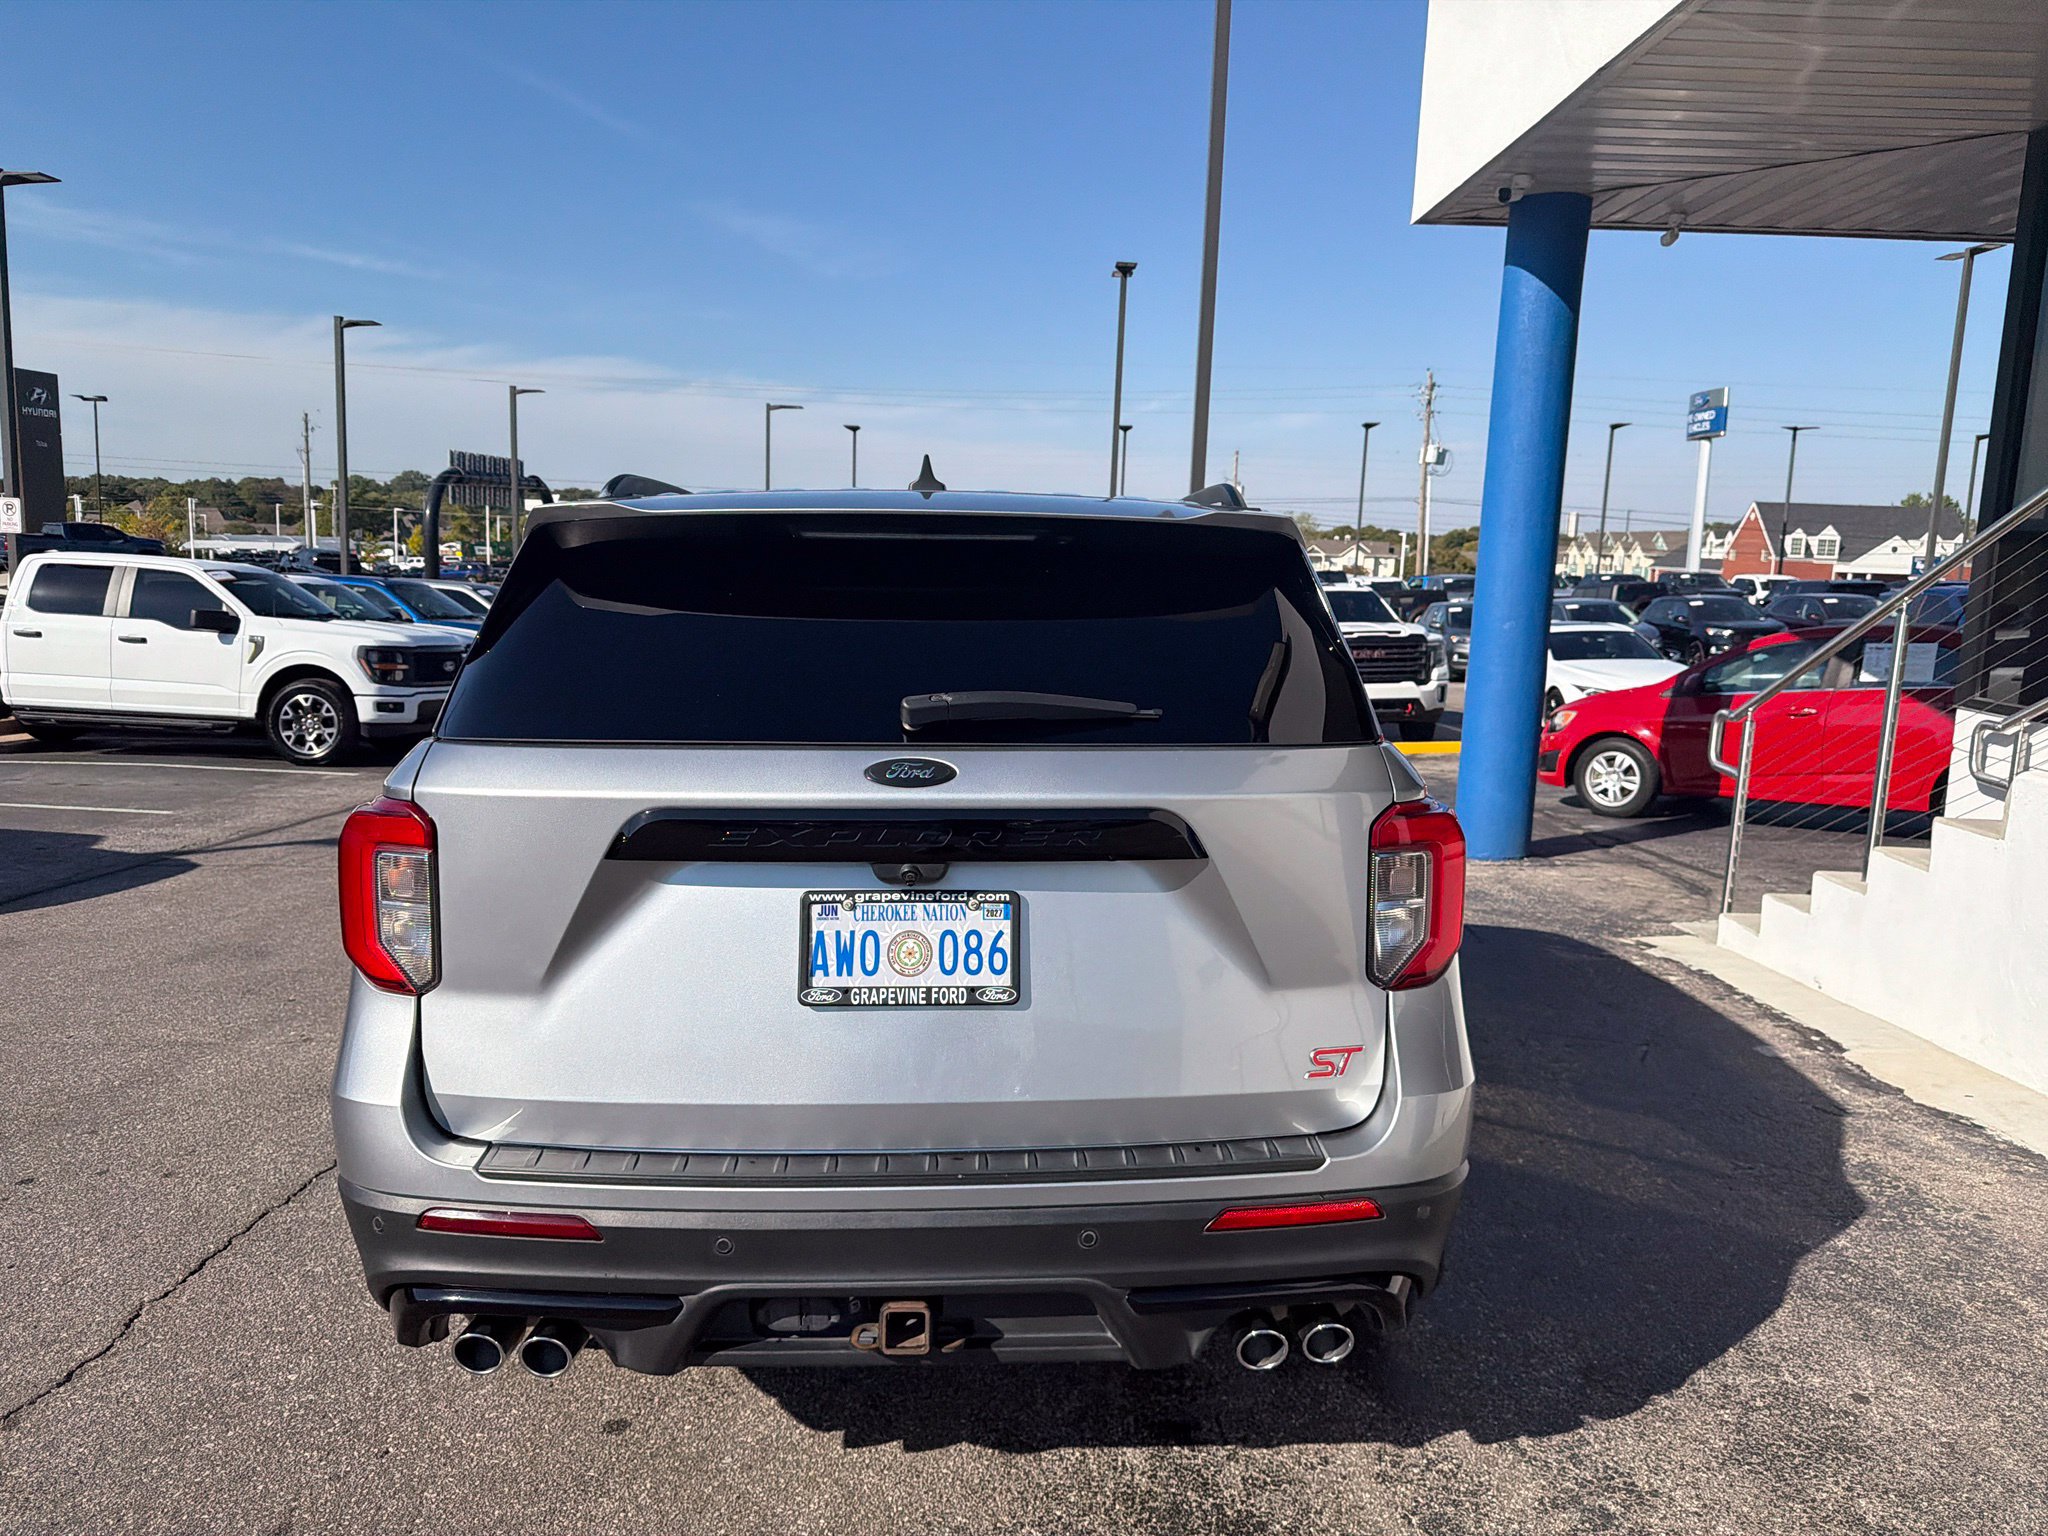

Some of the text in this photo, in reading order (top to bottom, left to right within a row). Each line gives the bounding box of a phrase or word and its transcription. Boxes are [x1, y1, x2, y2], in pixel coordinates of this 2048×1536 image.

[21, 405, 57, 418] HYUNDAI
[885, 761, 936, 779] Ford
[706, 827, 1103, 848] EXPLORER
[808, 891, 1010, 903] www.grapevineford.com
[817, 904, 839, 917] JUN
[853, 904, 967, 922] CHEROKEE NATION
[807, 988, 835, 1001] Ford
[850, 987, 967, 1005] GRAPEVINE FORD
[983, 987, 1010, 1001] Ford
[1304, 1045, 1365, 1079] ST
